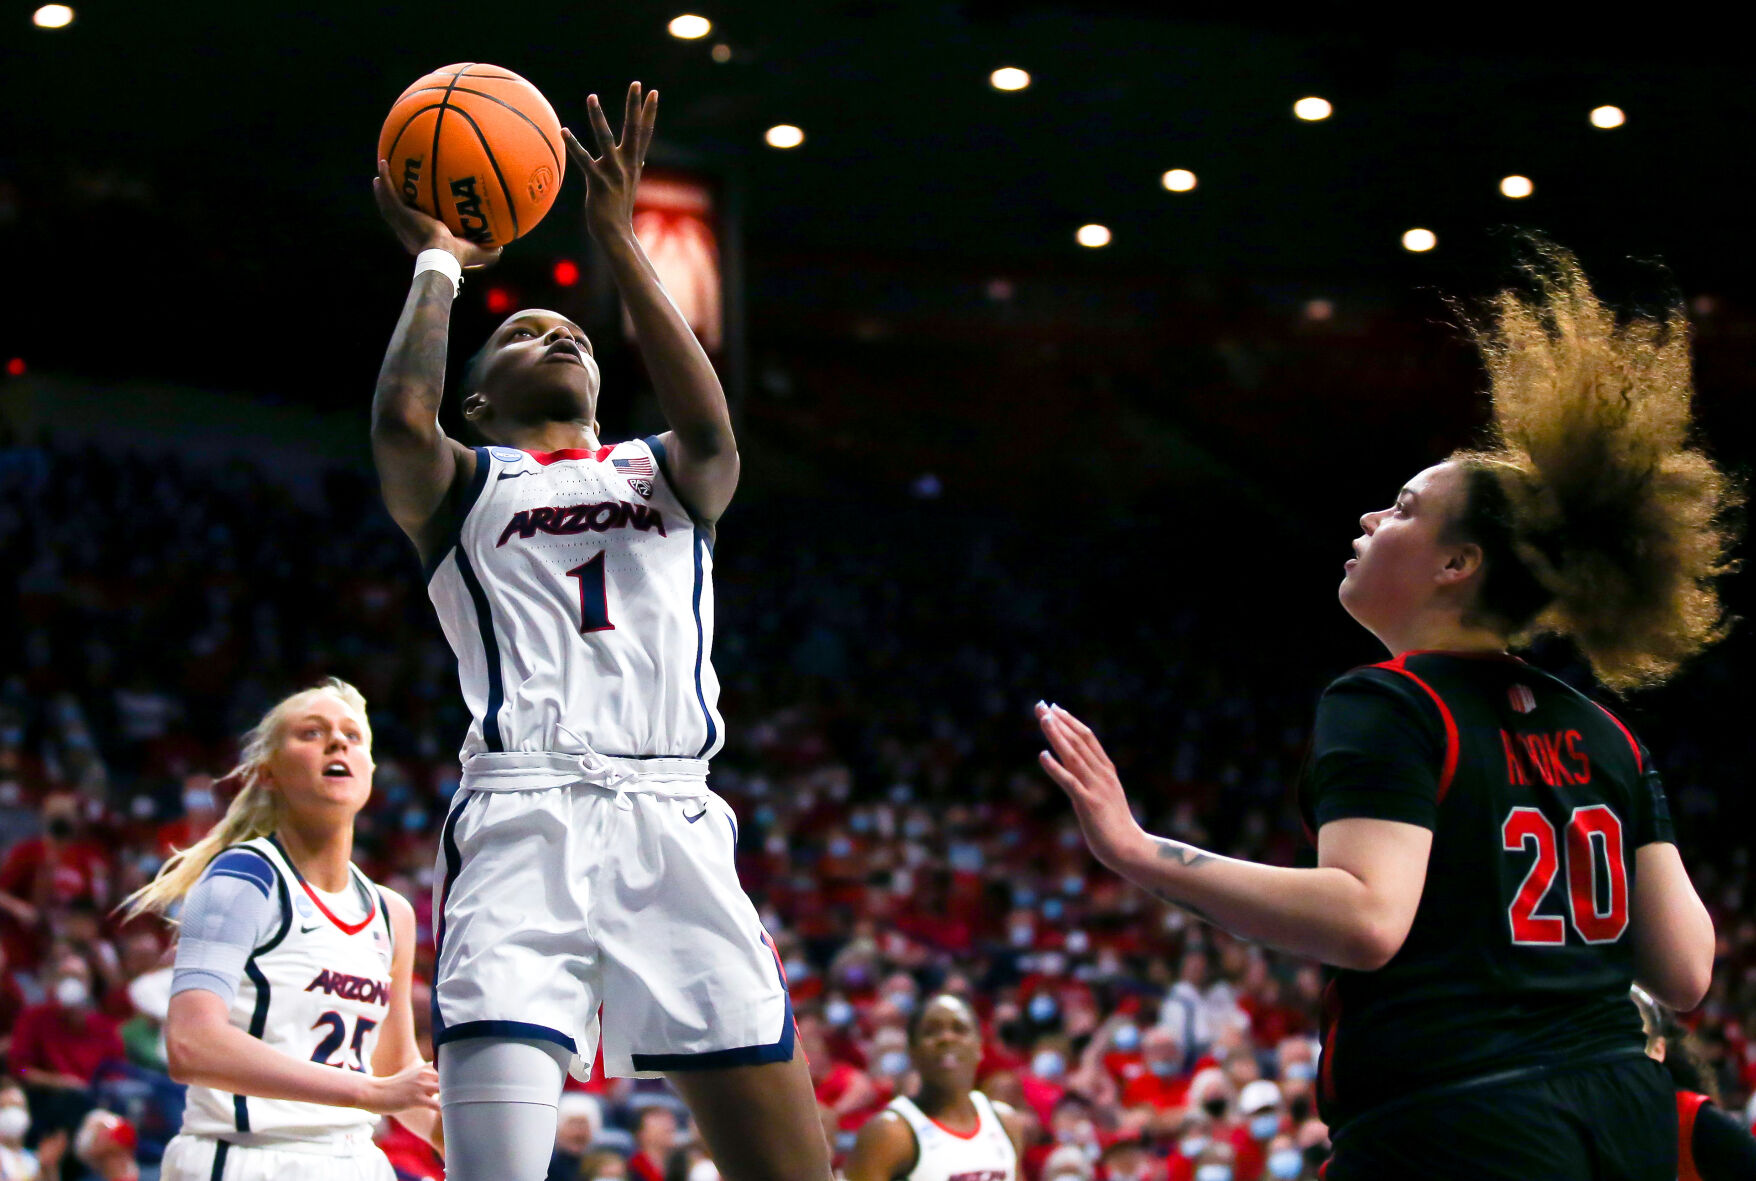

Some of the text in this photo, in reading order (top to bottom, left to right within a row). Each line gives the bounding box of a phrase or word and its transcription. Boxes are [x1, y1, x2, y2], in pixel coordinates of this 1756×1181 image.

[496, 500, 667, 548] ARIZONA
[566, 550, 615, 634] 1
[1502, 804, 1629, 946] 20
[304, 968, 390, 1007] ARIZON
